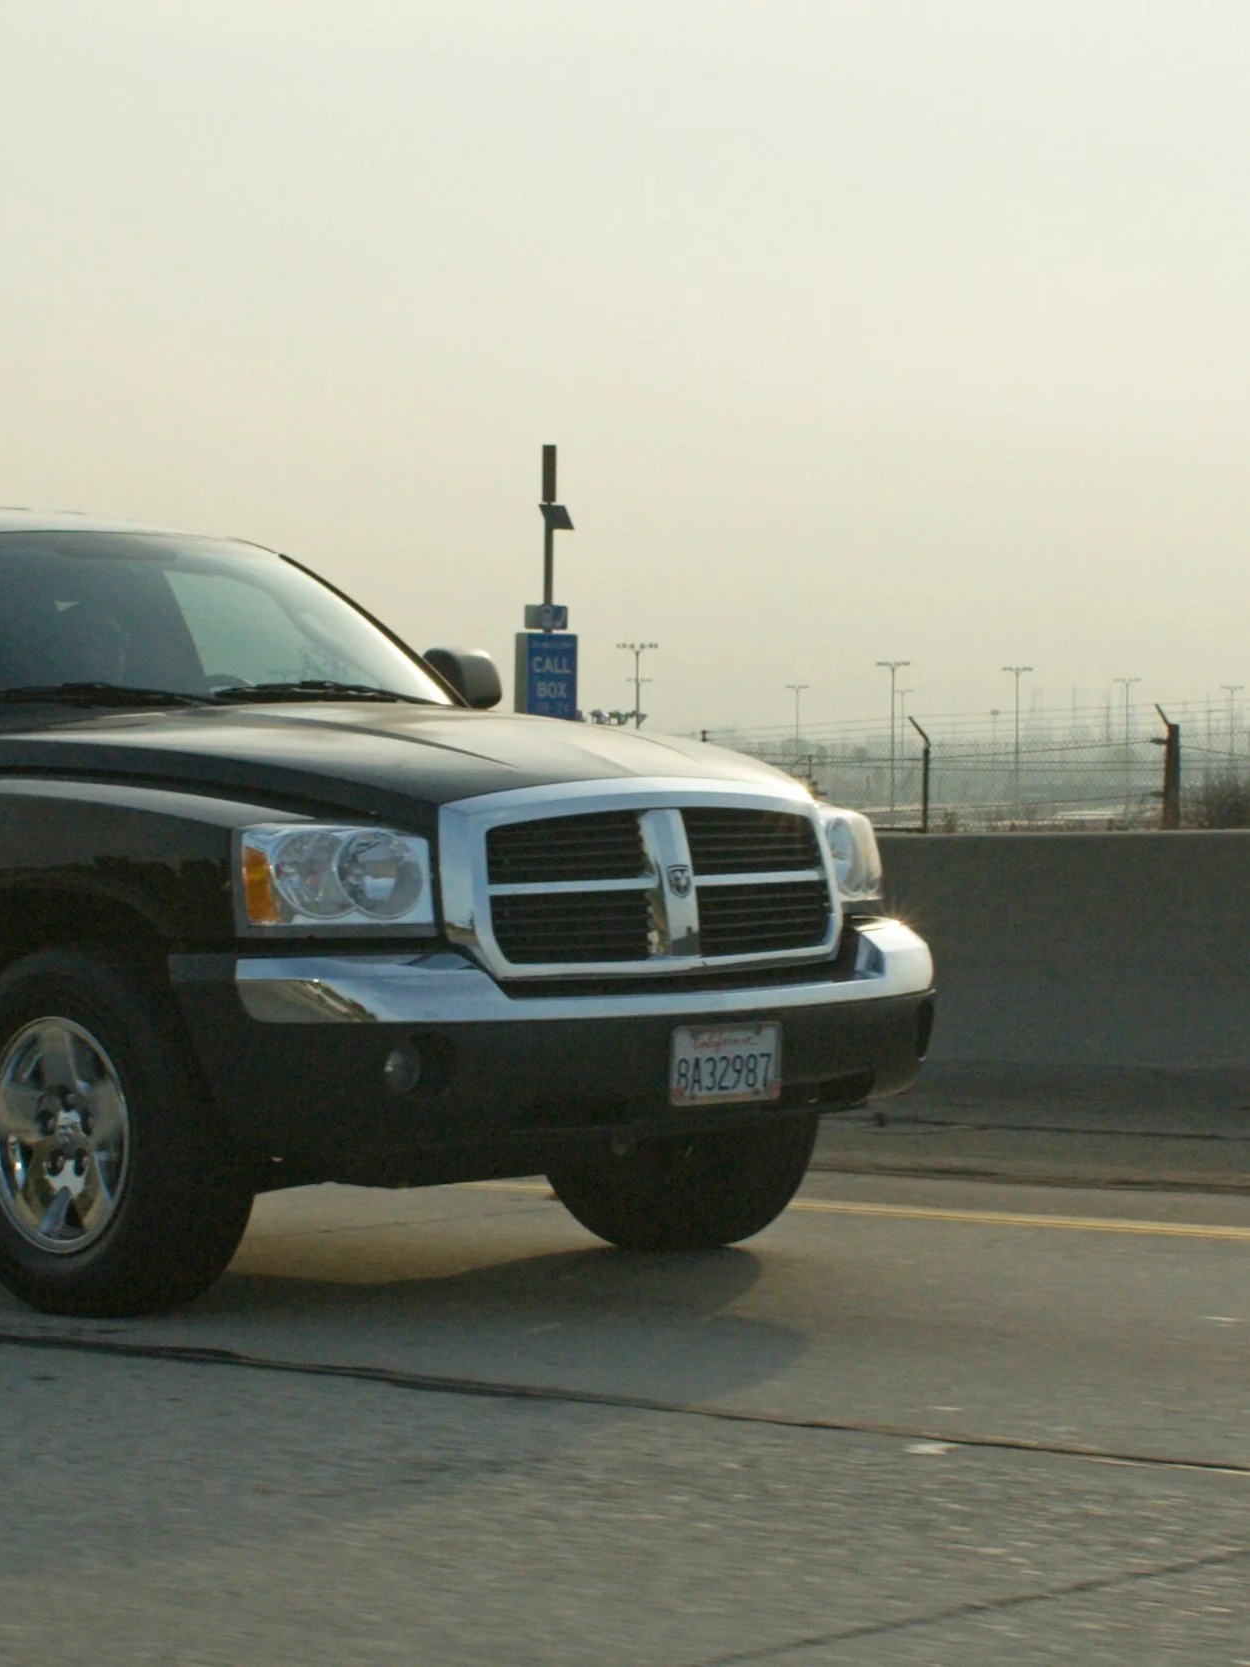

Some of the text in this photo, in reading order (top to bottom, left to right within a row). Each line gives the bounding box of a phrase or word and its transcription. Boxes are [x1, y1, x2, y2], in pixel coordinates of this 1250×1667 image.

[532, 656, 572, 673] CALL
[536, 682, 568, 699] BOX
[676, 1053, 772, 1092] 8A32987
